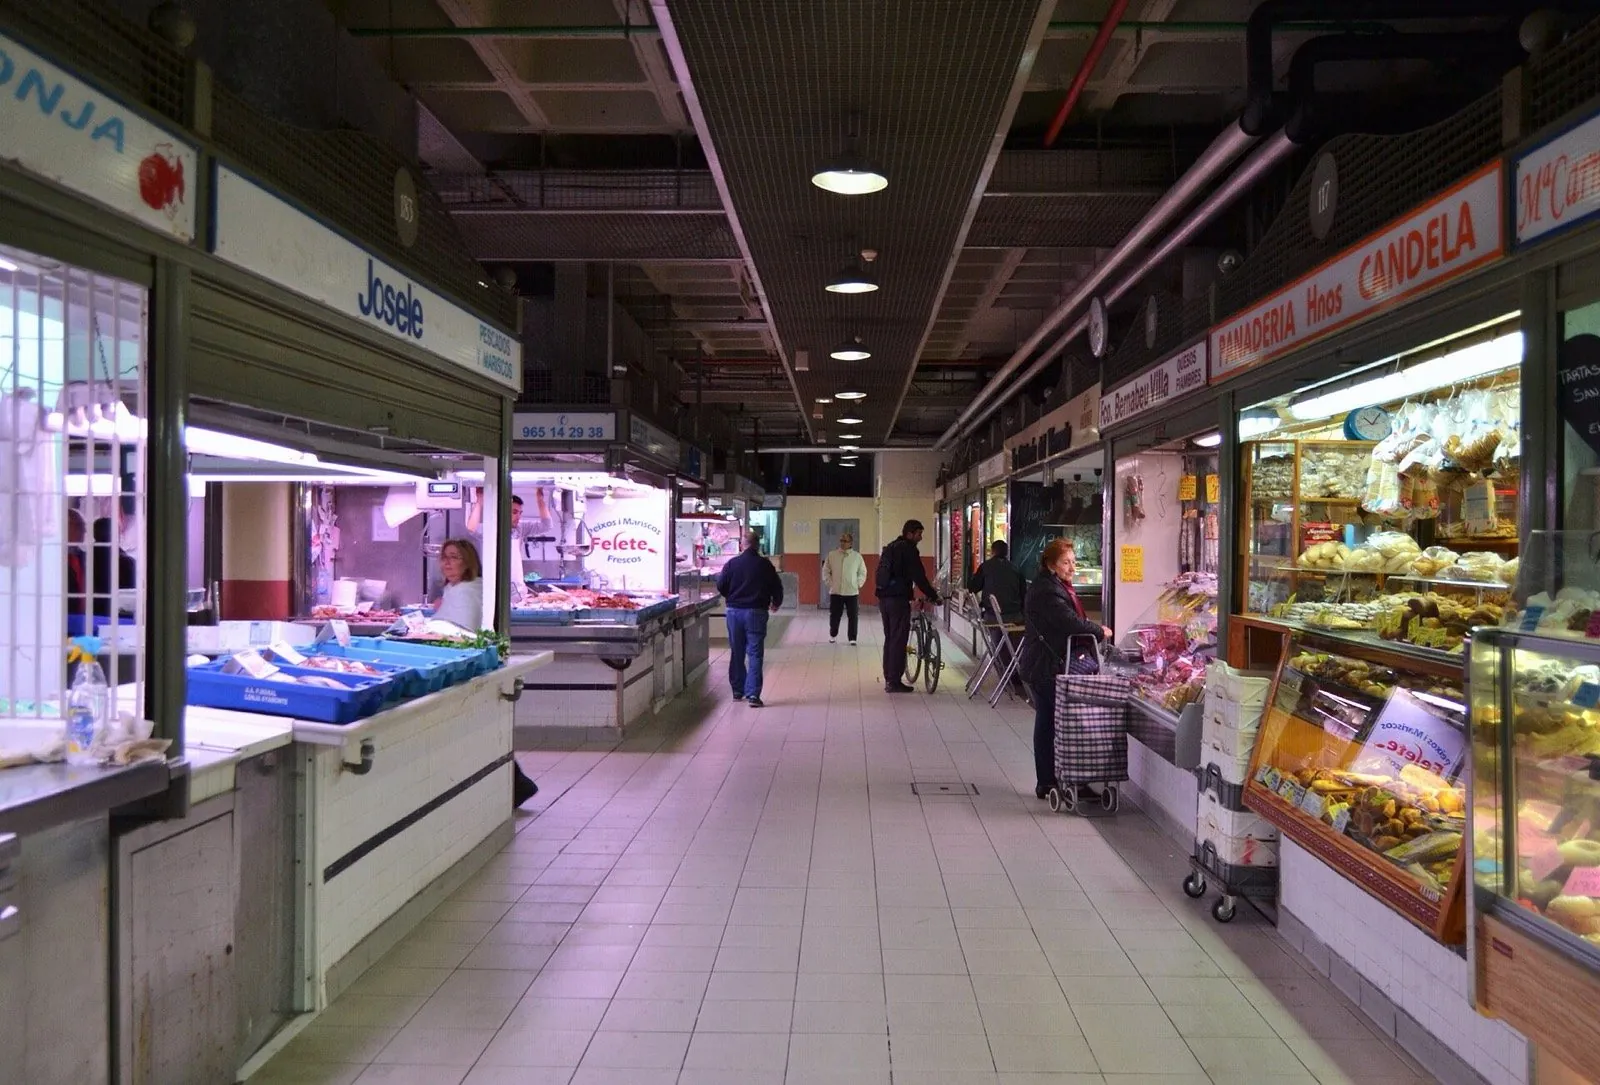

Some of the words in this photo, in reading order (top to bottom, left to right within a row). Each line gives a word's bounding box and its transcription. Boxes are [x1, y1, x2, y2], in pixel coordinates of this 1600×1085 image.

[1219, 300, 1296, 367] PANADERIA
[1307, 283, 1343, 326] Hnos
[1358, 200, 1476, 300] CANDELA
[358, 258, 424, 340] Josele
[479, 323, 511, 357] PESCADOS
[482, 352, 513, 380] MARISCOS
[1176, 350, 1197, 373] QUESOS
[1175, 368, 1202, 392] FIAMBRES
[1559, 365, 1600, 385] TARTAS
[1114, 382, 1150, 419] Bernabeu
[1149, 368, 1169, 401] Villa
[523, 427, 546, 438] 965
[550, 427, 564, 438] 14
[569, 427, 584, 438] 29
[588, 427, 603, 438] 38
[622, 517, 661, 536] Mariscos
[591, 531, 648, 550] Felete
[607, 554, 642, 564] Frescos
